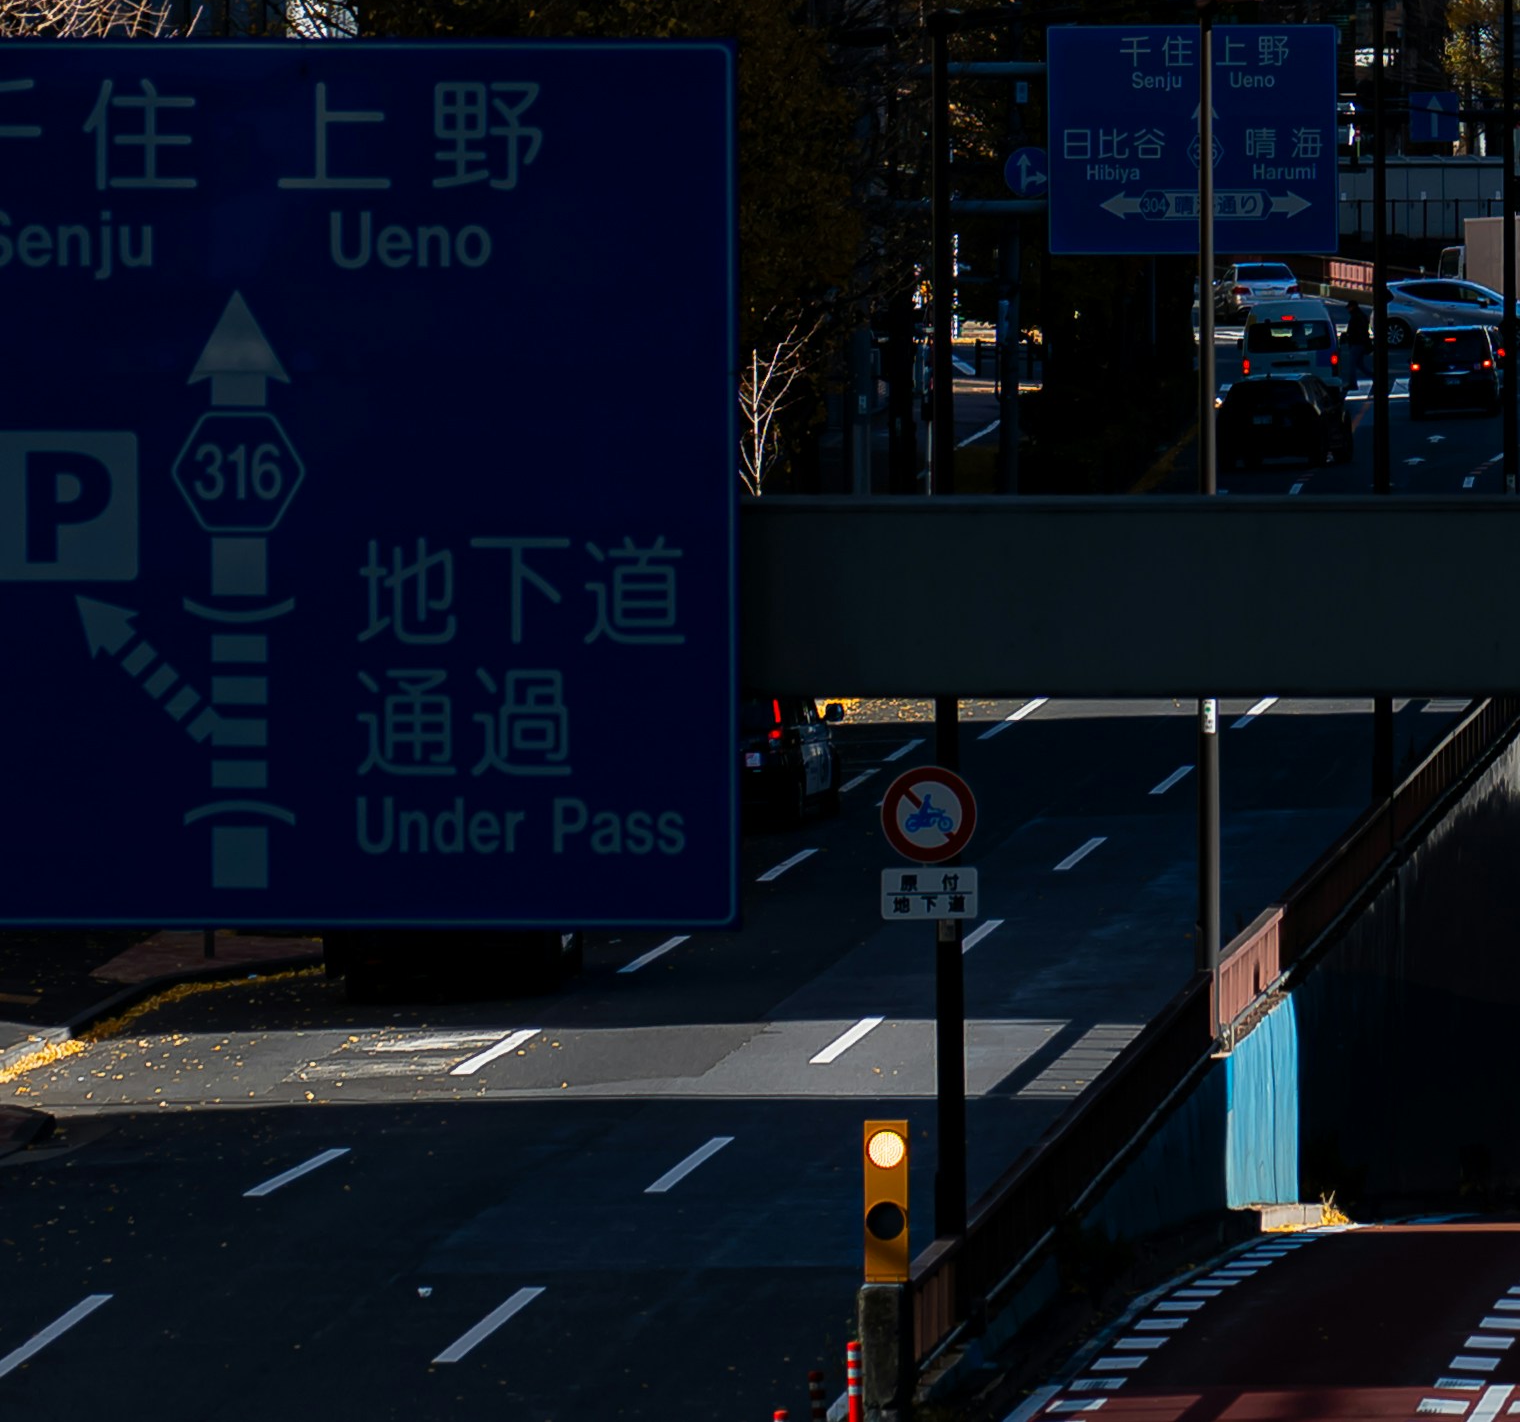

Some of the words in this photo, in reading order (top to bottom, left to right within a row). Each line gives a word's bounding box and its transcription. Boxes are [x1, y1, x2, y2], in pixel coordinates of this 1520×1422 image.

[1120, 36, 1194, 68] 千住
[1215, 36, 1289, 67] 上野
[1131, 72, 1182, 91] Senju
[1229, 73, 1275, 87] Ueno
[277, 80, 543, 189] 上野
[1064, 129, 1166, 159] 日比谷
[1245, 127, 1323, 159] 晴海
[1086, 163, 1141, 183] Hibiya
[1252, 163, 1317, 180] Harumi
[1143, 197, 1167, 213] 304
[1174, 195, 1258, 215] 晴通り
[329, 212, 492, 268] Ueno
[194, 444, 282, 501] 316
[24, 450, 114, 565] P
[357, 536, 686, 644] 地下道
[357, 667, 573, 776] 通過
[355, 797, 525, 855] Under
[553, 797, 686, 855] Pass
[901, 873, 959, 892] 原付
[893, 894, 965, 913] 地下道
